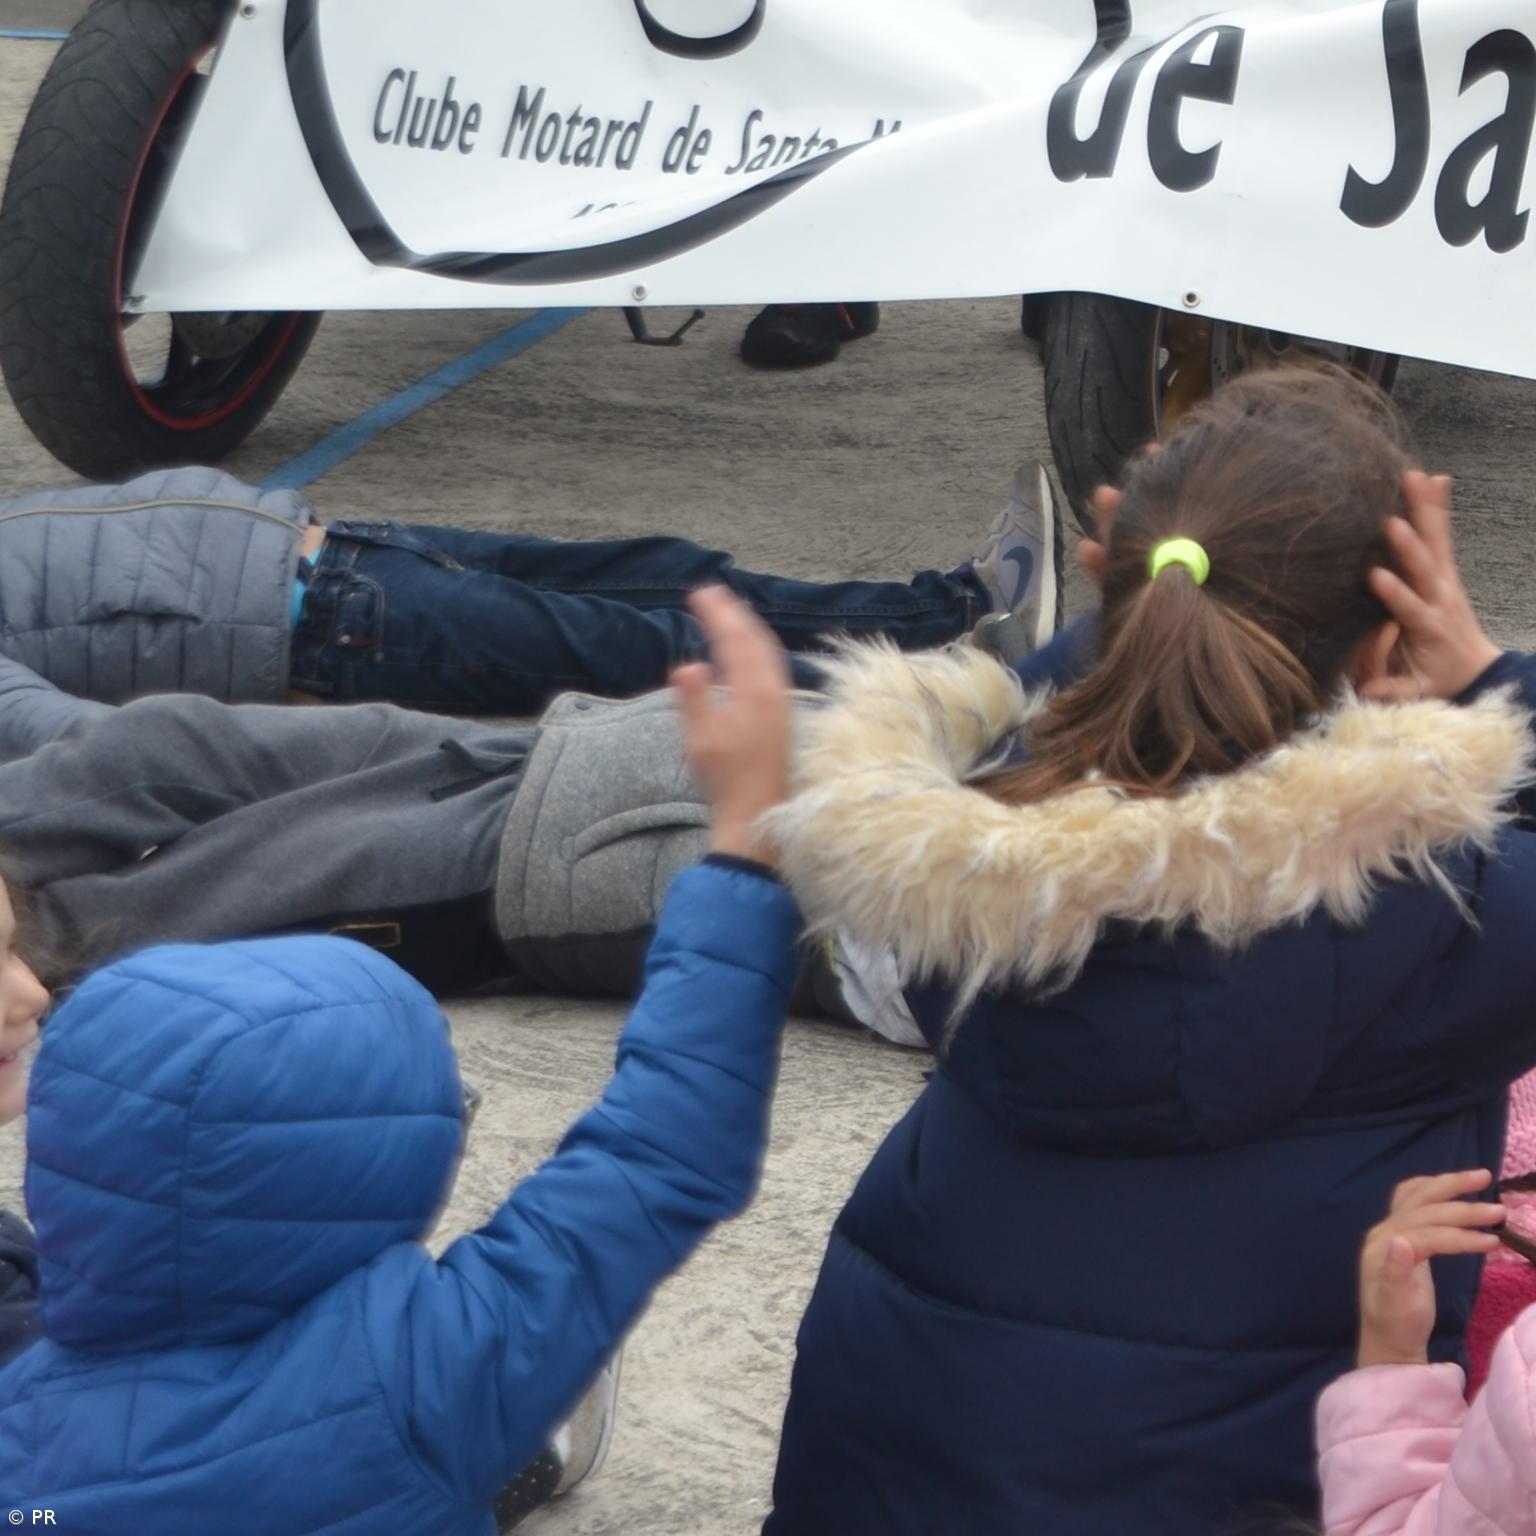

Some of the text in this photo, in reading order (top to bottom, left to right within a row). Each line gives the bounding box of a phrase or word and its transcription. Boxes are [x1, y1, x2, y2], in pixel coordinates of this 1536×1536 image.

[373, 68, 482, 156] Clube
[500, 84, 654, 172] Motard
[661, 104, 713, 175] de
